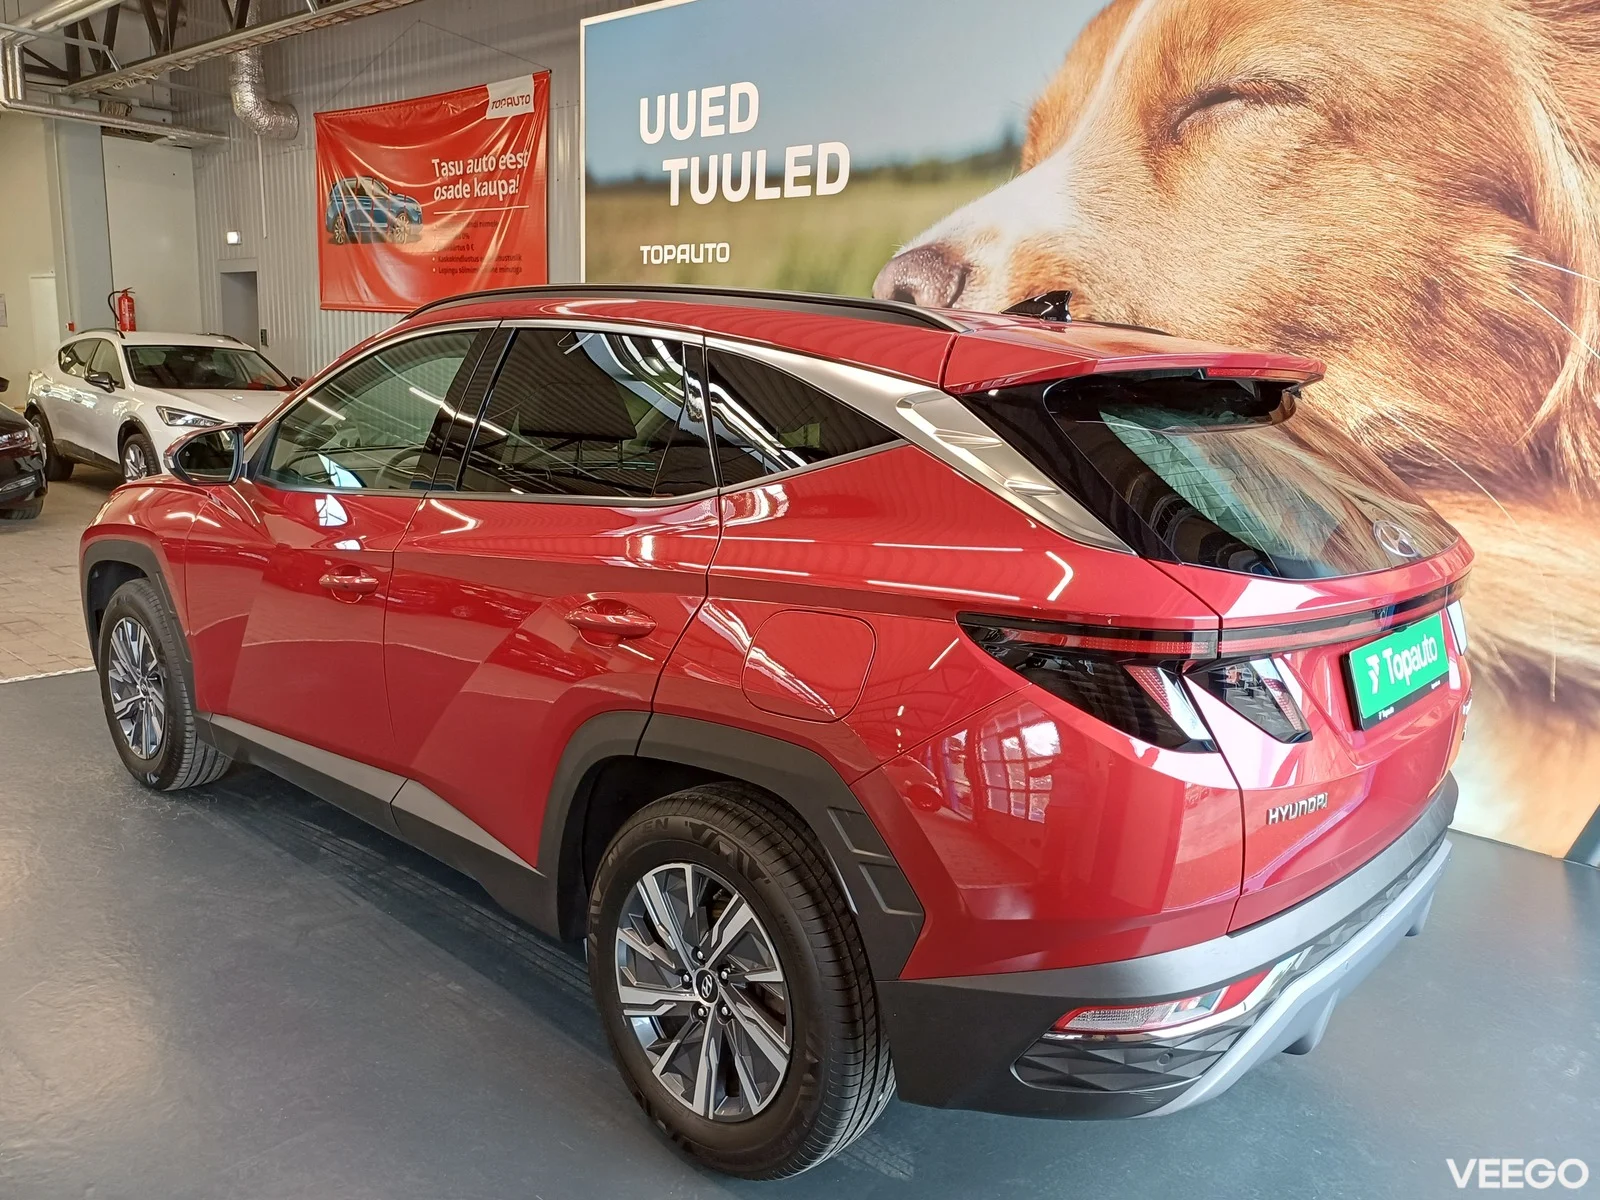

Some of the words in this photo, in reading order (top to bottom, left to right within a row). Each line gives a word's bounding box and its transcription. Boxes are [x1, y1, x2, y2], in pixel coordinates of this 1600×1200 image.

[491, 94, 531, 110] TOPAUTO
[639, 81, 760, 145] UUED
[431, 158, 464, 178] Tasu
[466, 154, 497, 175] auto
[498, 151, 529, 170] eest
[662, 141, 851, 207] TUULED
[433, 178, 471, 201] osade
[473, 174, 520, 202] kaupa!
[639, 242, 731, 265] TOPAUTO
[1382, 633, 1438, 686] Topauto
[1266, 792, 1329, 826] HYUNDAI
